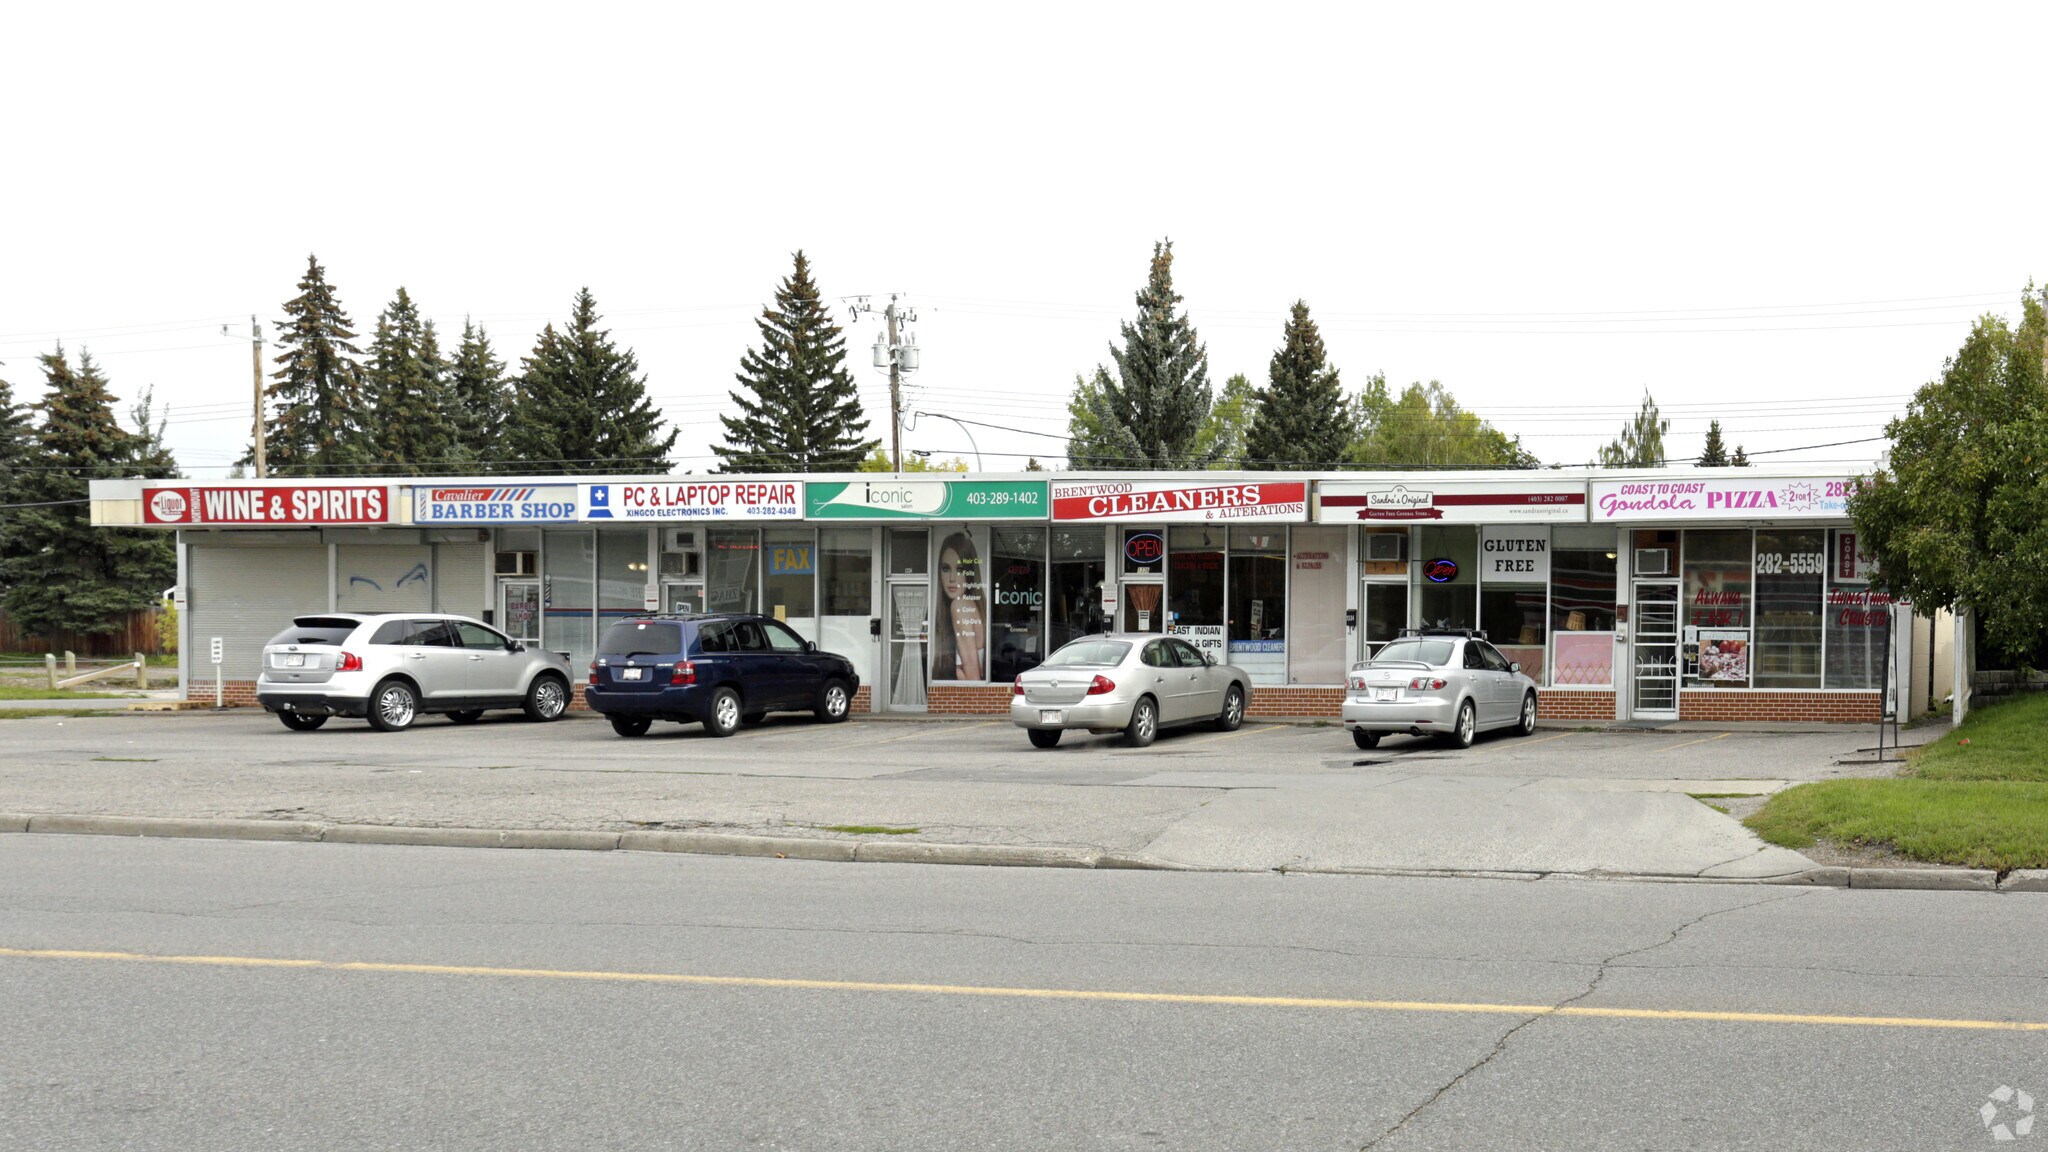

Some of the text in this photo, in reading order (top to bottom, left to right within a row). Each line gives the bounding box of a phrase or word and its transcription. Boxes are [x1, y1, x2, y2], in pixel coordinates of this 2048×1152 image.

[435, 489, 484, 501] Cavalier
[624, 484, 796, 506] PC & LAPTOP REPAIR
[866, 482, 912, 503] iconic
[1054, 483, 1132, 498] BRENTWOOD
[1621, 483, 1705, 495] COAST TO COAST
[1789, 491, 1795, 502] 2
[1806, 491, 1811, 502] 1
[204, 489, 382, 520] WINE & SPIRITS
[966, 491, 1038, 504] 403-289-1402
[1089, 486, 1261, 516] CLEANERS
[1371, 493, 1429, 508] Sandra's Original
[1600, 491, 1778, 517] Gondola PIZZA
[432, 503, 575, 518] BARBER SHOP
[626, 507, 796, 516] XINGCO ELECTRONICS INC. 403-282-4348
[1206, 504, 1303, 519] & ALTERATIONS
[1127, 541, 1162, 557] OPEN
[1484, 539, 1546, 552] GLUTEN
[773, 548, 811, 570] FAX
[1495, 559, 1534, 572] FREE
[1757, 552, 1824, 574] 282-5559
[1423, 561, 1457, 577] Open
[995, 582, 1043, 605] iconic
[1195, 627, 1220, 635] INDIAN
[1195, 640, 1199, 648] &
[1202, 640, 1222, 648] GIFTS
[1229, 642, 1285, 652] BRENTWOOD CLEANERS
